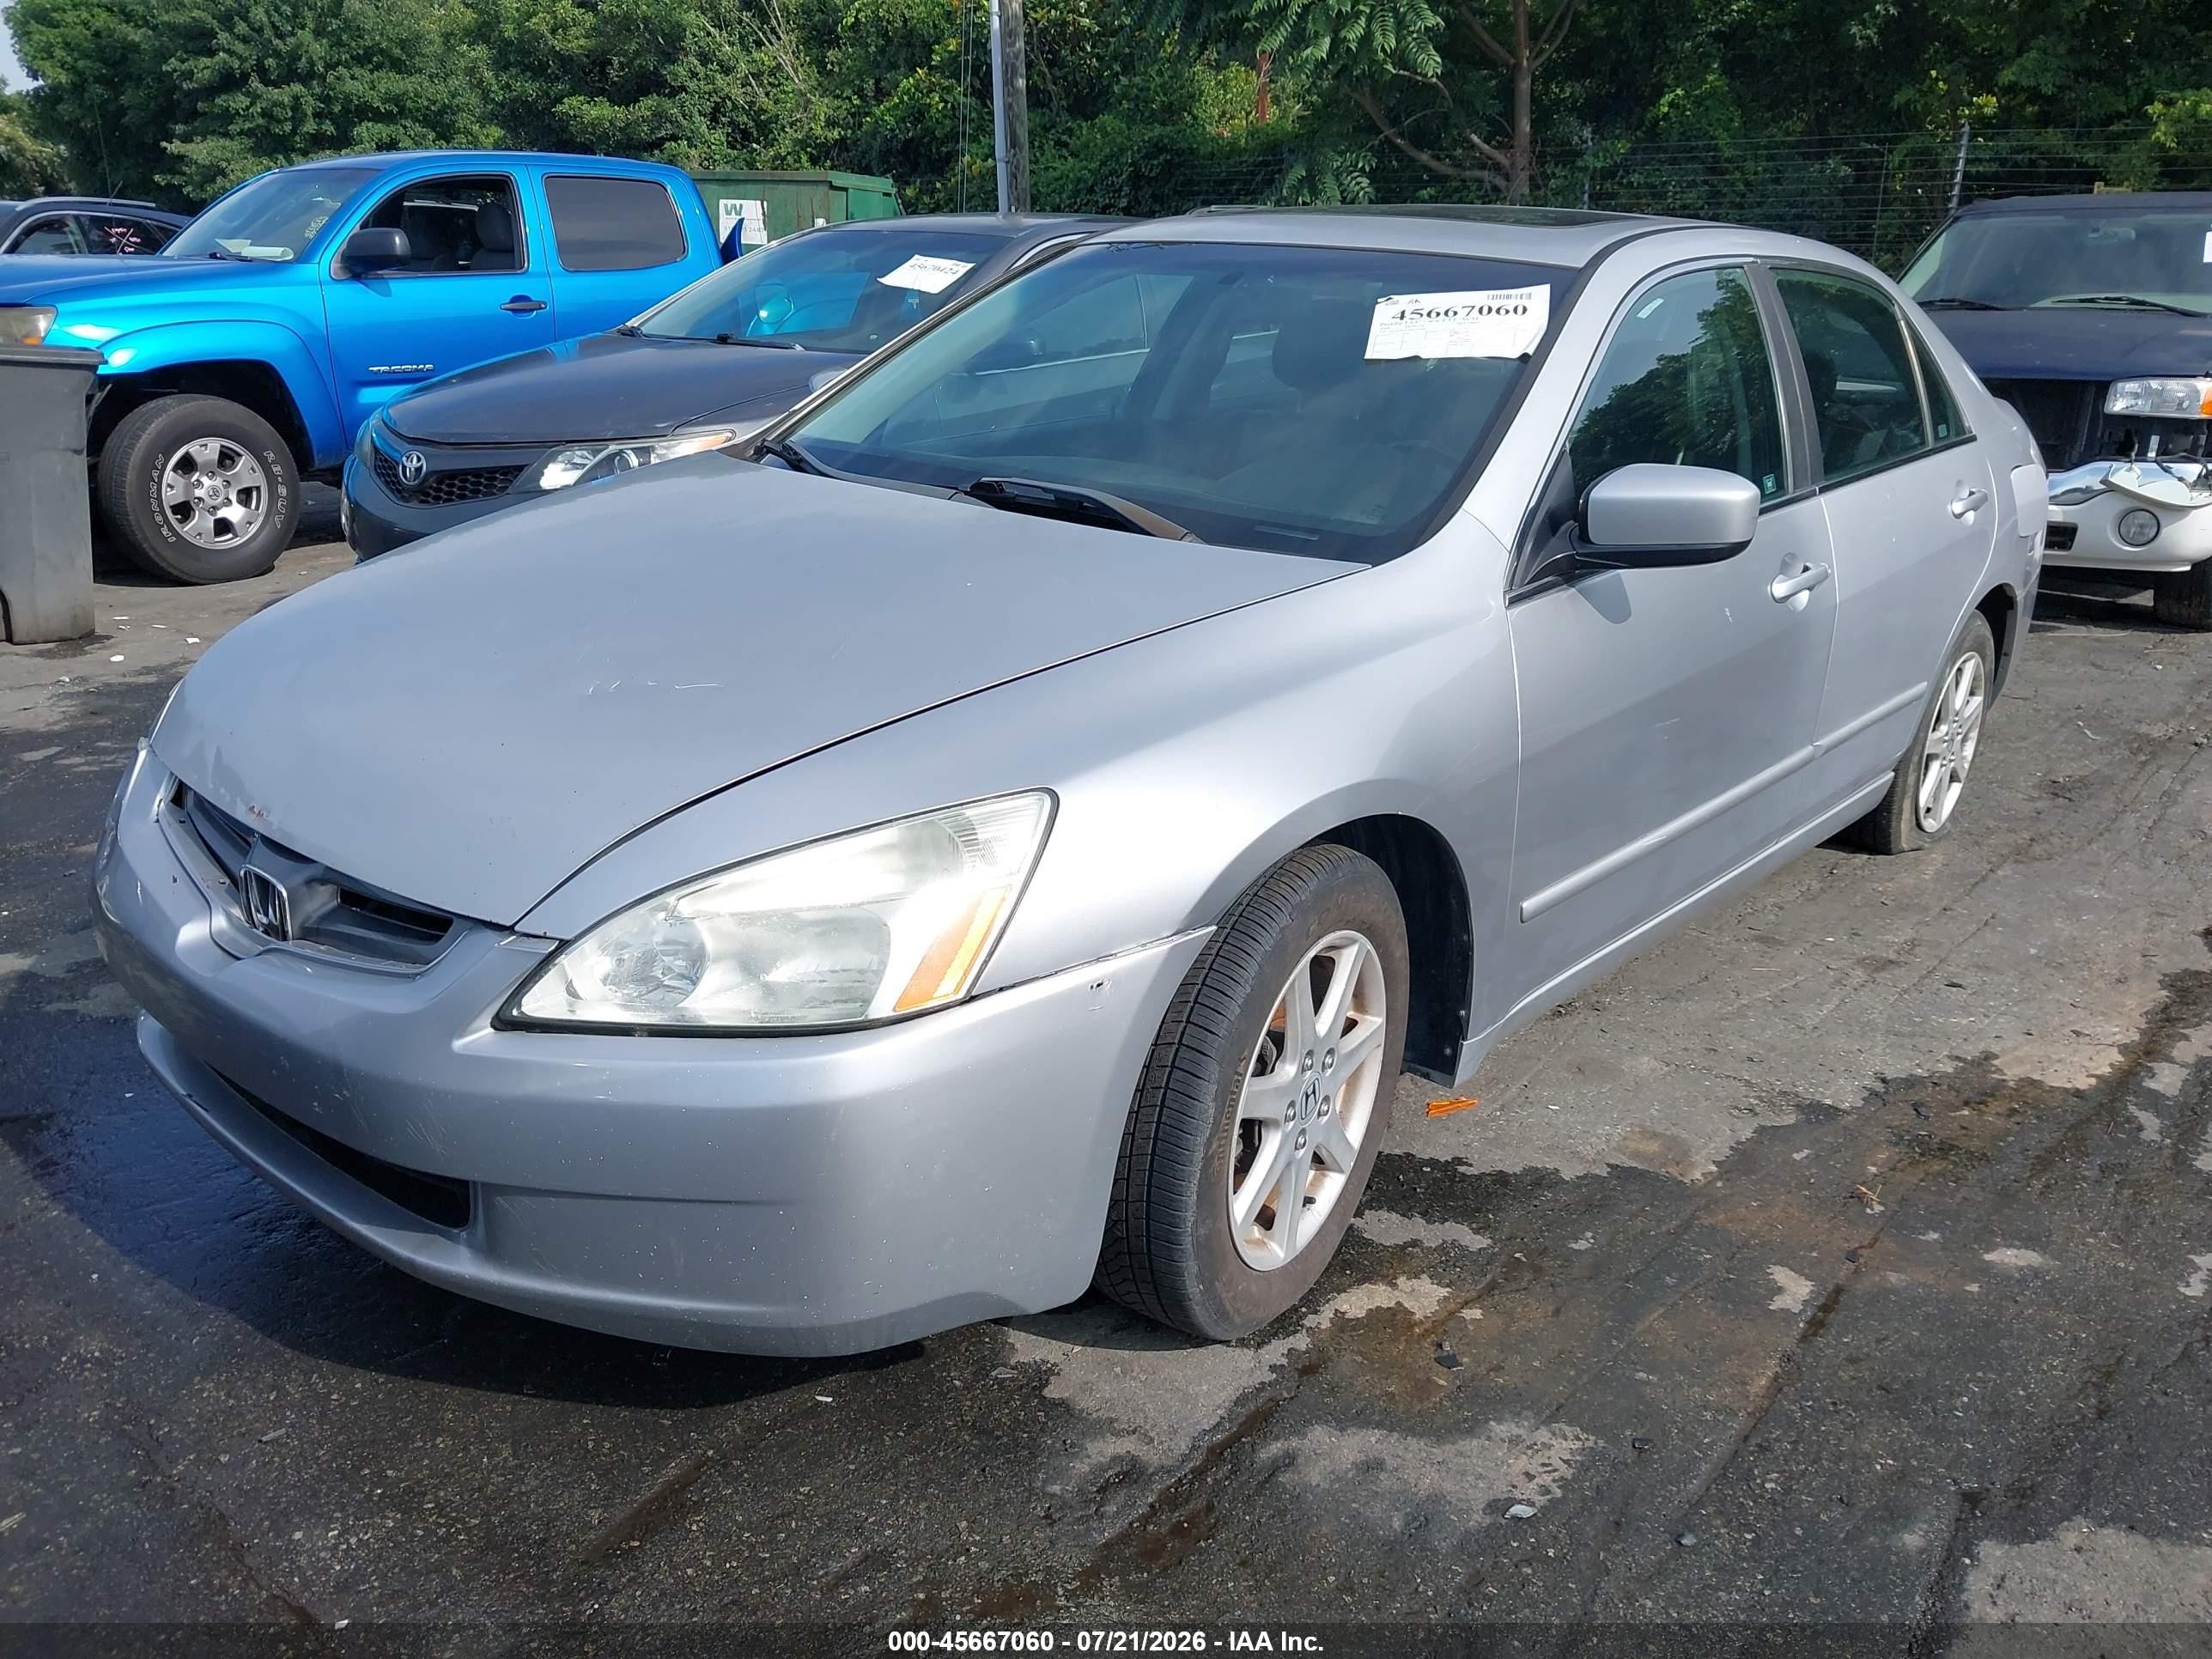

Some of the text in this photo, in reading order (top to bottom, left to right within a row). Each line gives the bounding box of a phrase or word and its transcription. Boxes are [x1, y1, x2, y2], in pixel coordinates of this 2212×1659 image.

[1391, 303, 1528, 321] 45667060
[368, 363, 434, 373] TACOMA
[149, 453, 177, 544] IRONMAN
